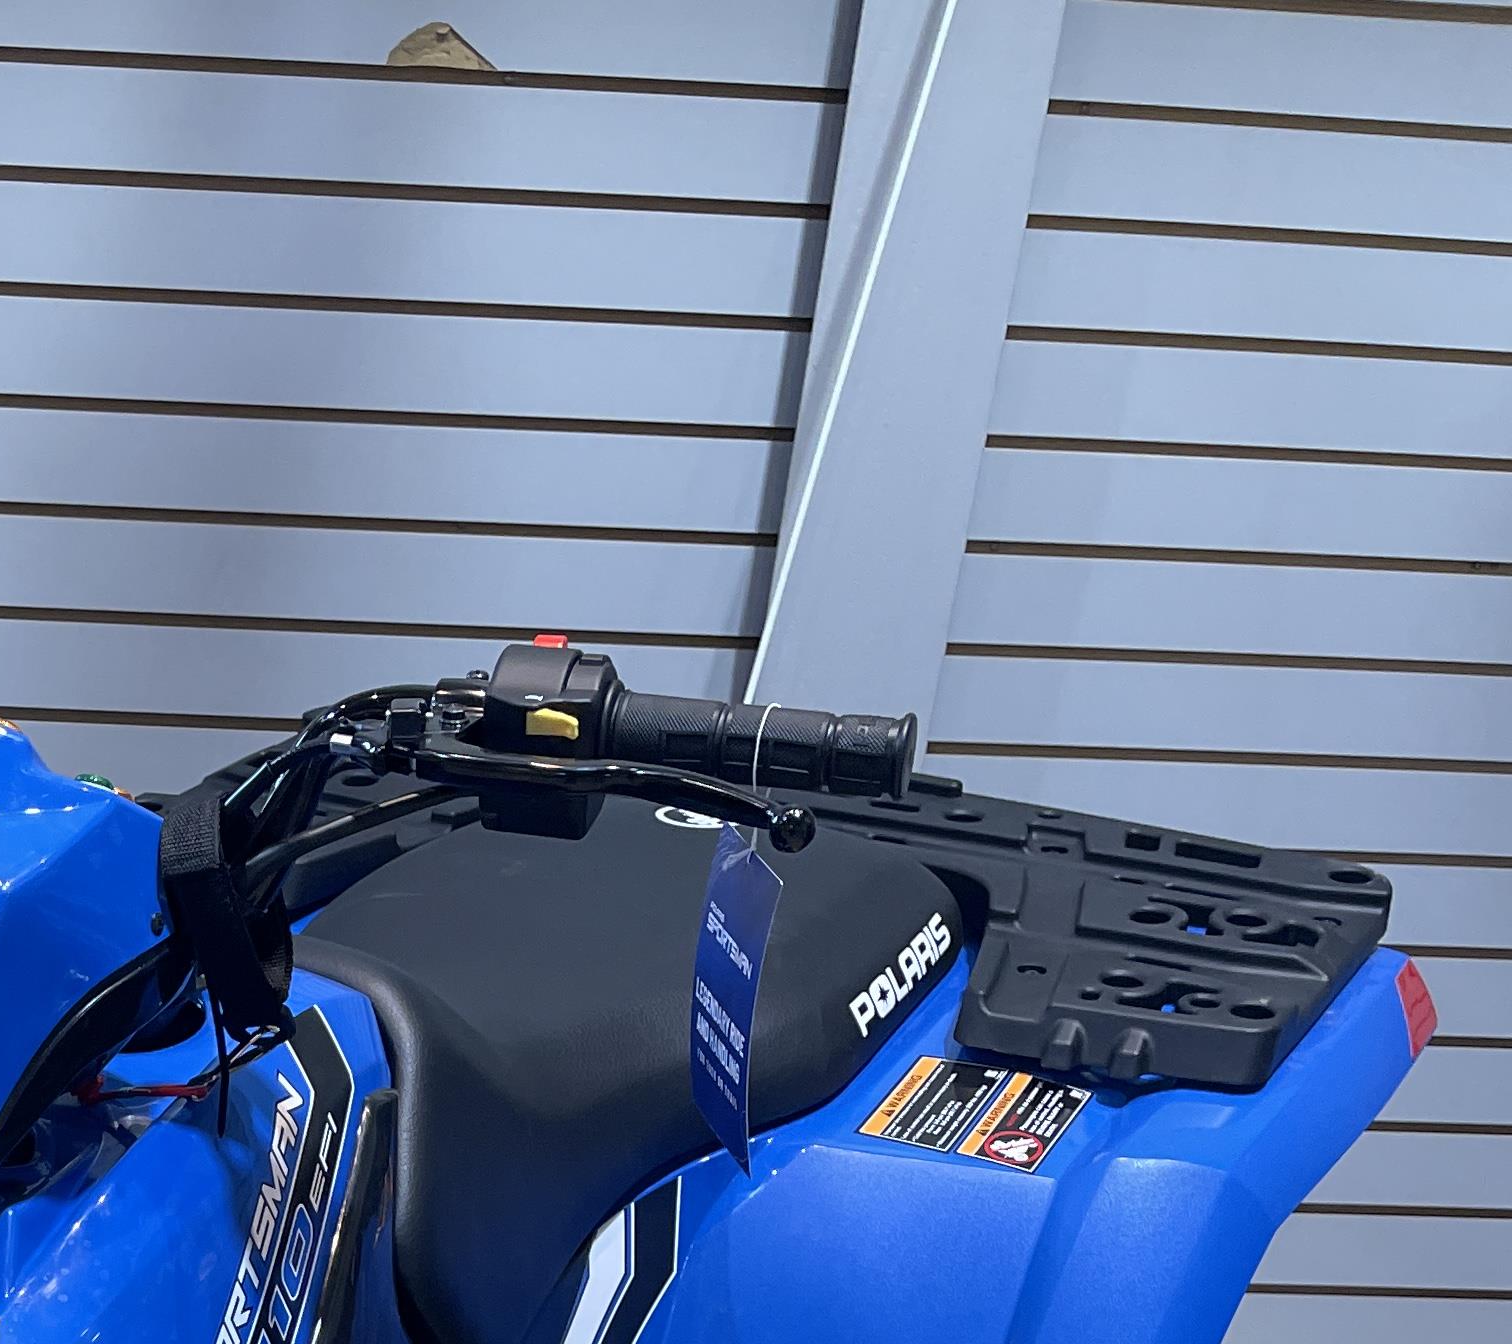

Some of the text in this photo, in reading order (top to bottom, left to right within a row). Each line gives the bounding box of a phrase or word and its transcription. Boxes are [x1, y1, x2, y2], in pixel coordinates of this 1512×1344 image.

[849, 912, 952, 1038] POLARIS
[891, 1074, 923, 1111] WARNING
[982, 1091, 1016, 1129] WARNING
[308, 1112, 338, 1214] EFI
